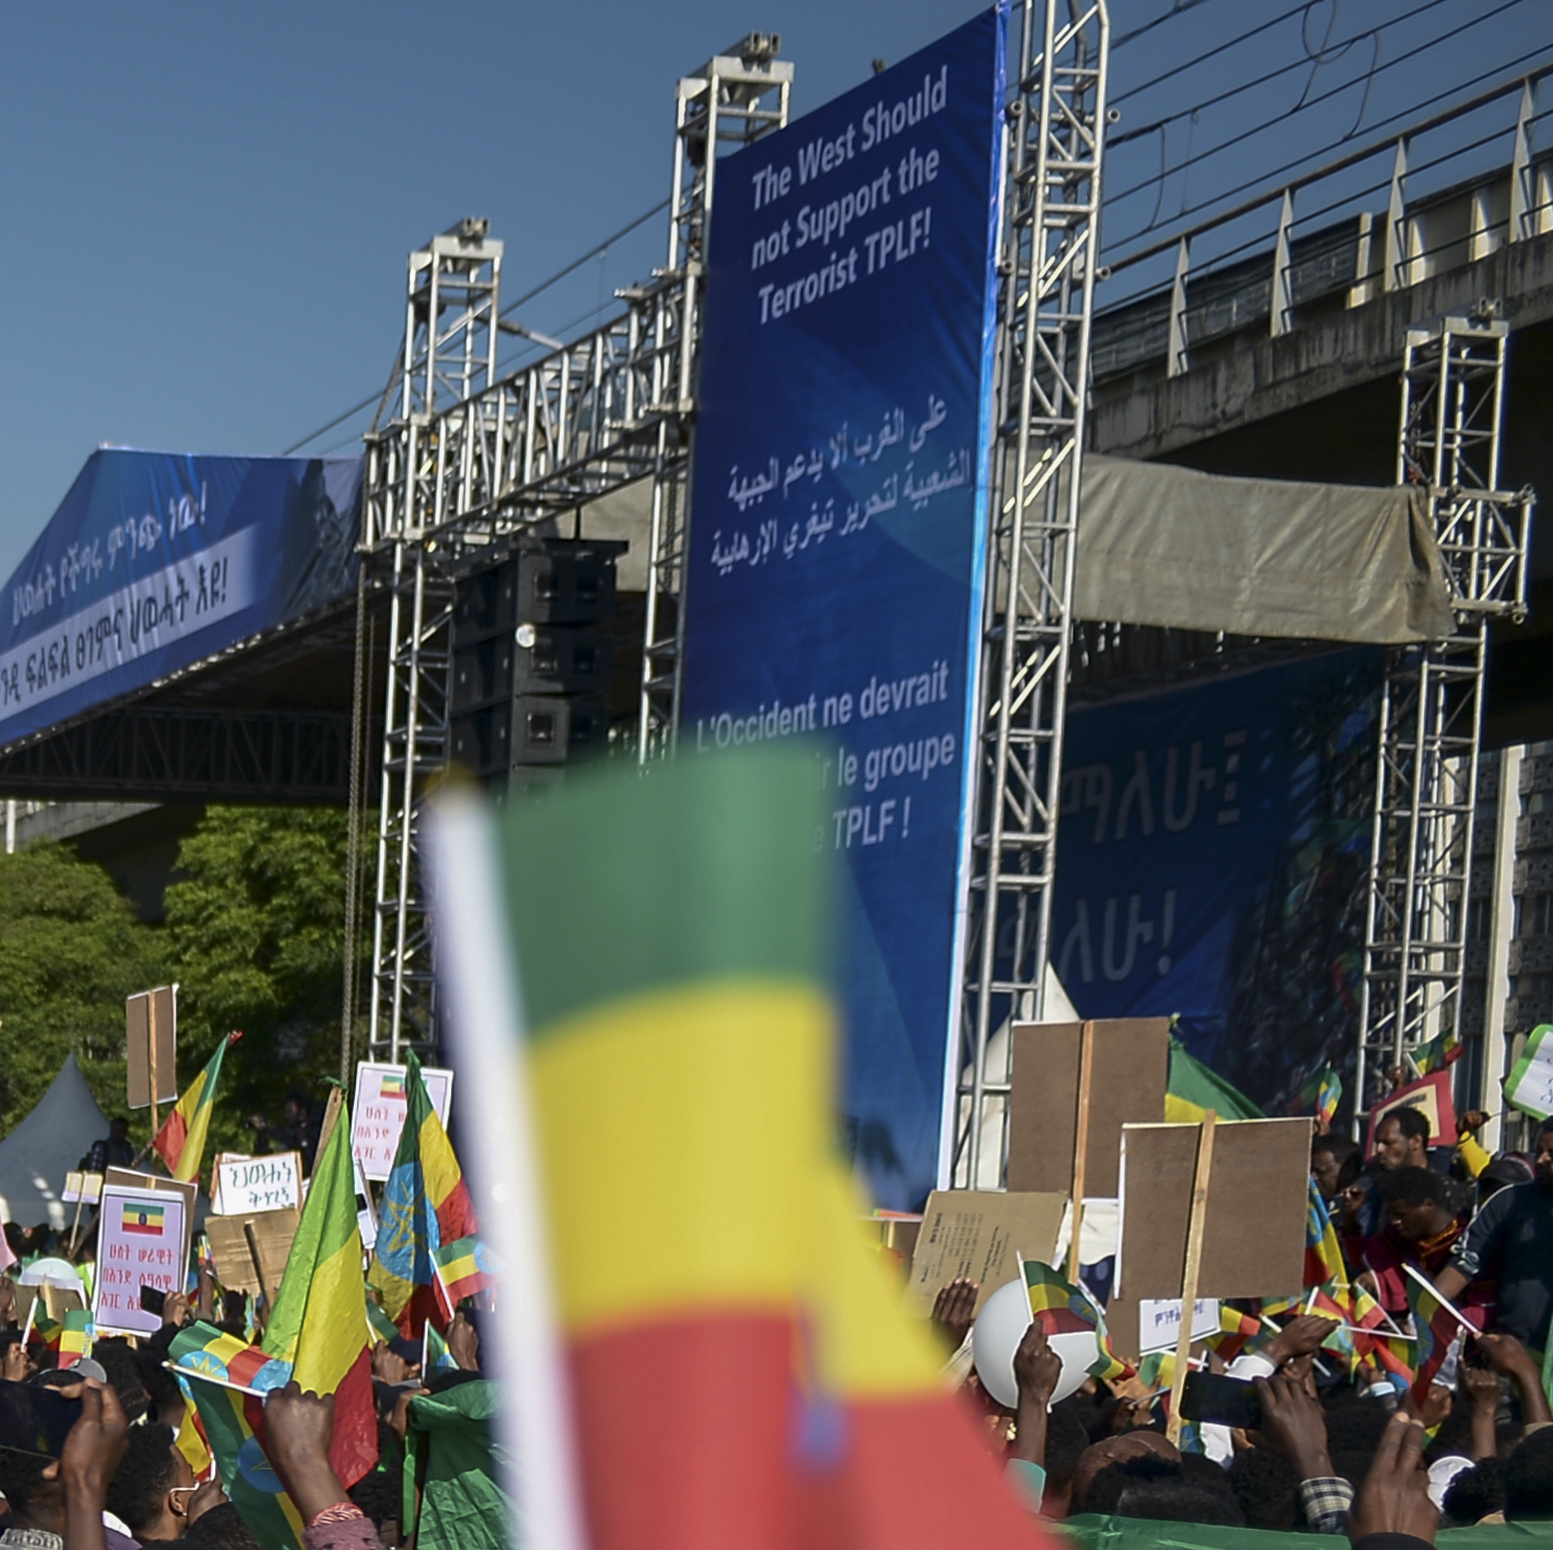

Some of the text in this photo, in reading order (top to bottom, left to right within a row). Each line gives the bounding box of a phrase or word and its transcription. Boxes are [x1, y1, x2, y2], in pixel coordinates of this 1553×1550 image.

[751, 64, 948, 212] The West Should
[751, 147, 940, 271] not Support the
[757, 206, 932, 325] Terrorist TPLF!
[854, 407, 904, 466] الغرب
[909, 394, 947, 452] على
[728, 456, 779, 512] الجبهة
[783, 449, 824, 500] يدعم
[838, 472, 899, 536] لتحرير
[903, 449, 971, 511] الشعبية
[696, 659, 949, 754] L'Occident ne devrait
[837, 746, 858, 787] le
[864, 732, 956, 792] groupe
